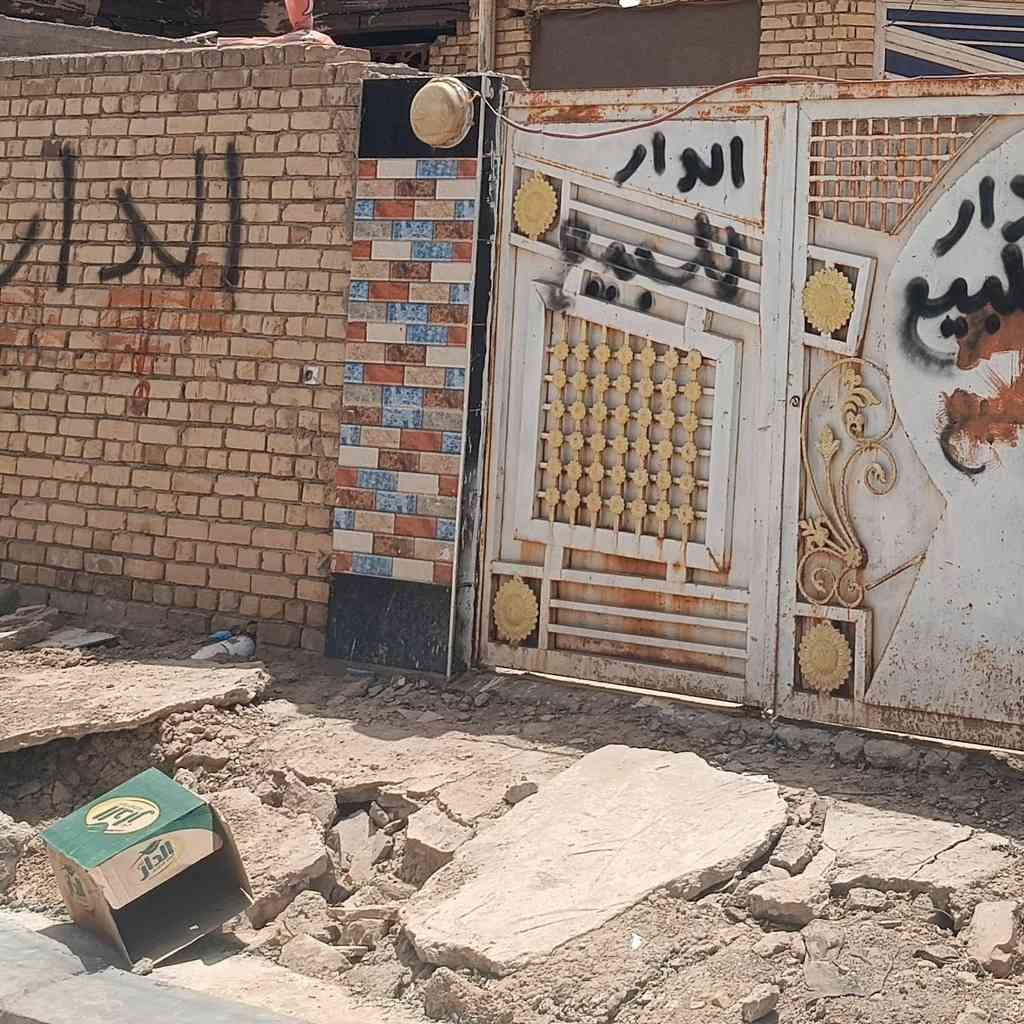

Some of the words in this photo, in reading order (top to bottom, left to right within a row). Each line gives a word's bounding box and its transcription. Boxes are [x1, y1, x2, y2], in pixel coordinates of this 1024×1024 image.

[613, 131, 746, 193] الدار
[0, 141, 243, 292] الدار
[139, 841, 175, 881] الدار
